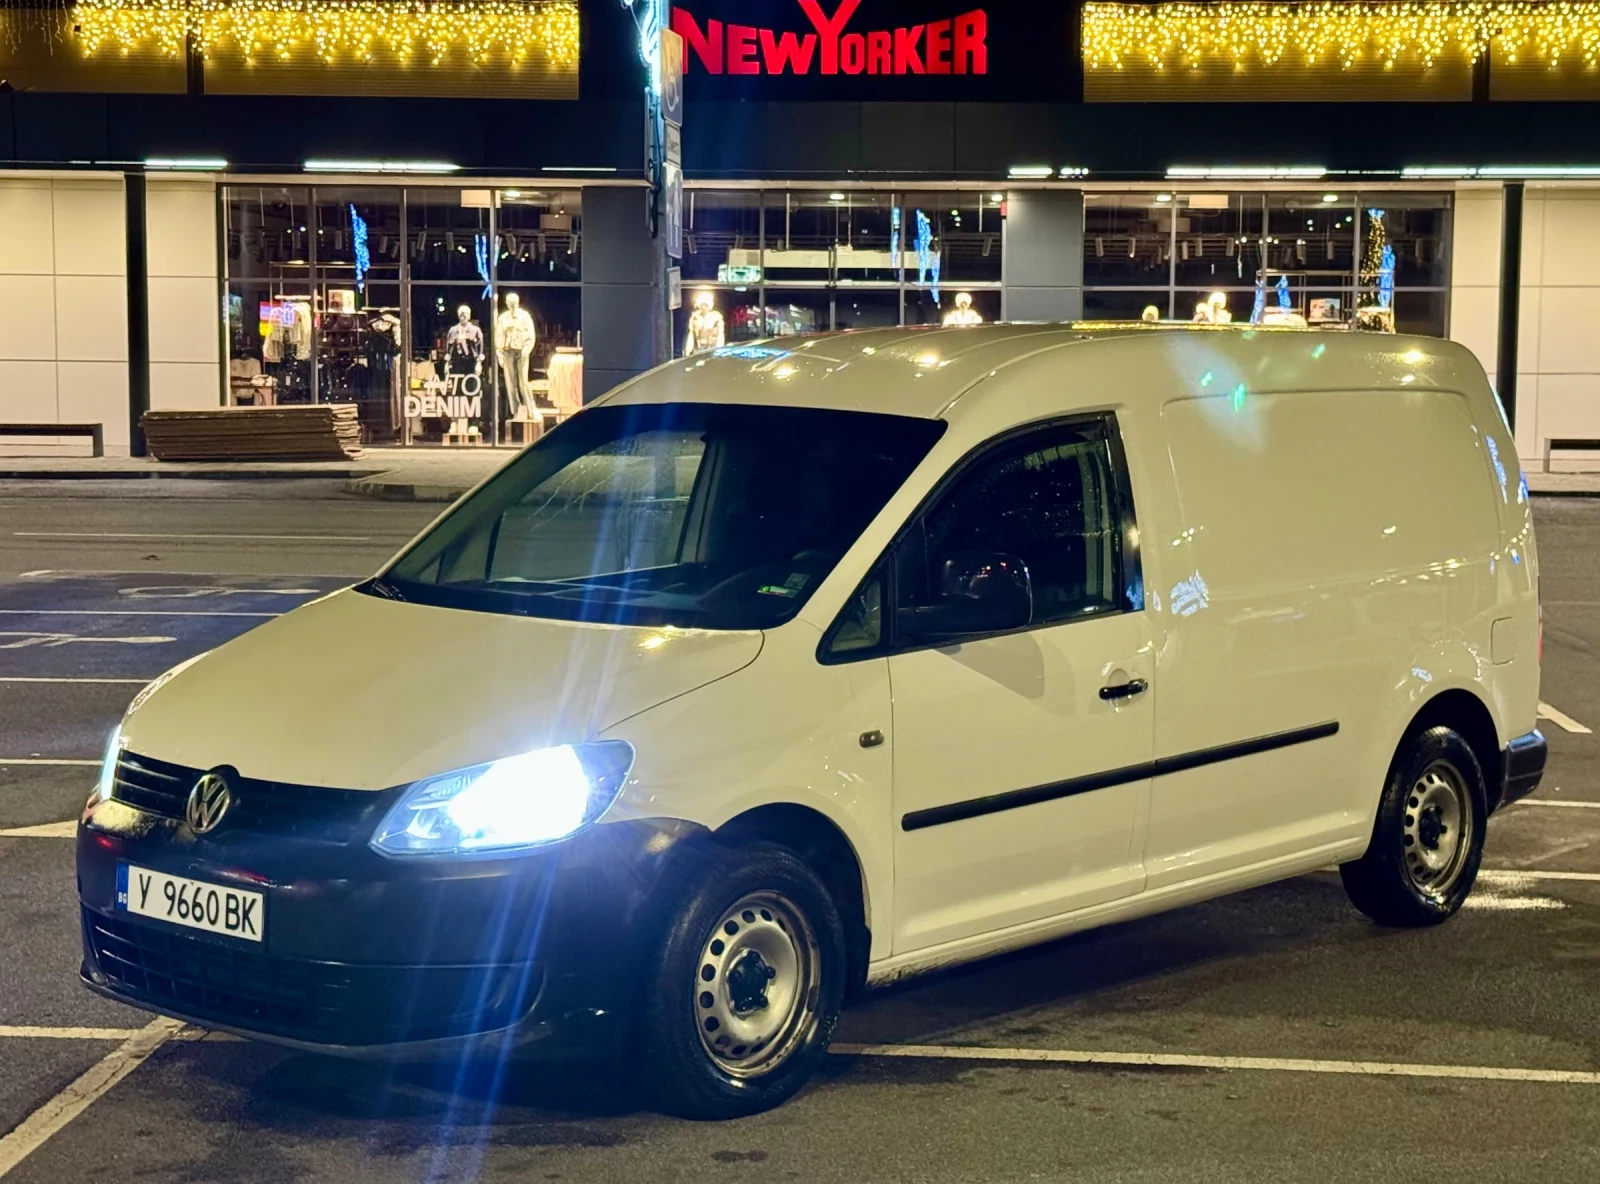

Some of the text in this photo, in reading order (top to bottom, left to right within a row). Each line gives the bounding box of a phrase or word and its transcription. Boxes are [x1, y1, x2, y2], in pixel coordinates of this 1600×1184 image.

[426, 373, 482, 396] INTO
[404, 395, 482, 418] DENIM
[118, 891, 128, 904] BG
